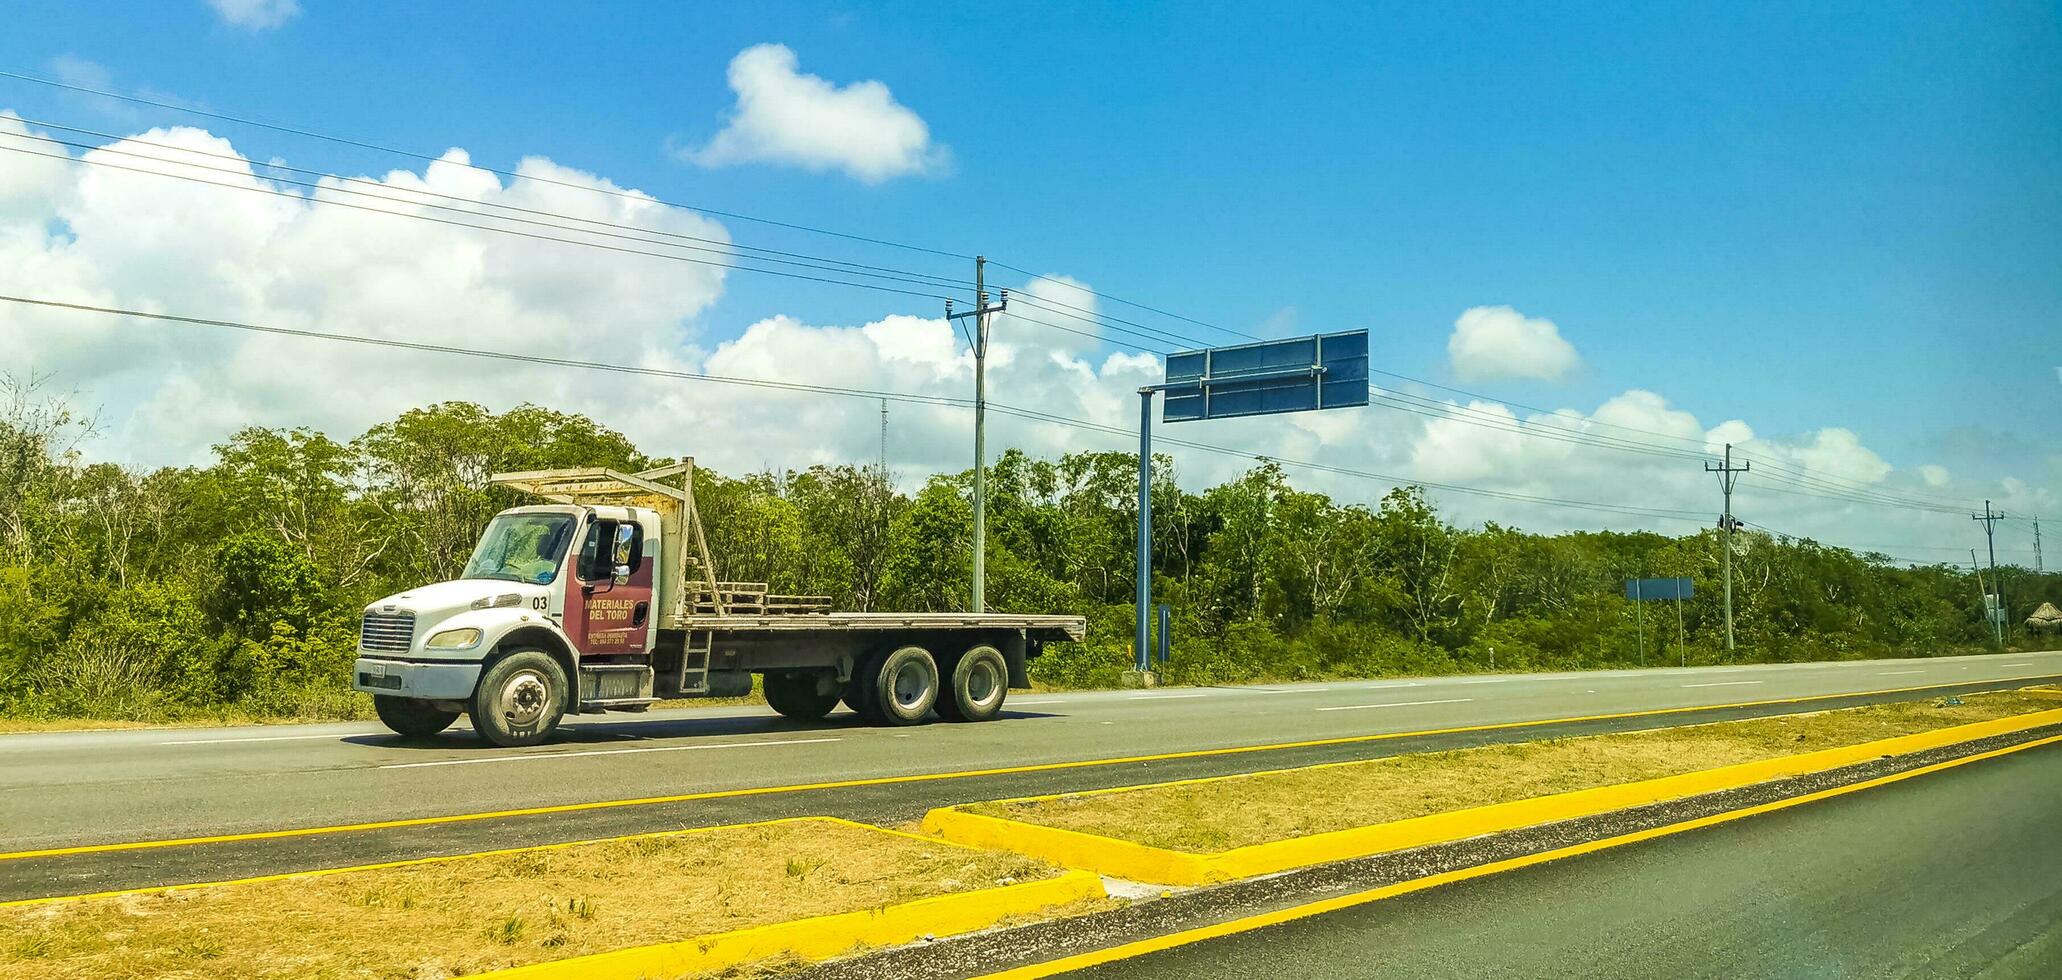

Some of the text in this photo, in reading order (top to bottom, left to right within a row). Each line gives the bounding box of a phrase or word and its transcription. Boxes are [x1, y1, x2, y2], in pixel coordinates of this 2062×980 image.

[532, 596, 547, 610] 03
[585, 599, 634, 610] MATERIALES
[589, 610, 628, 620] DEL TORO
